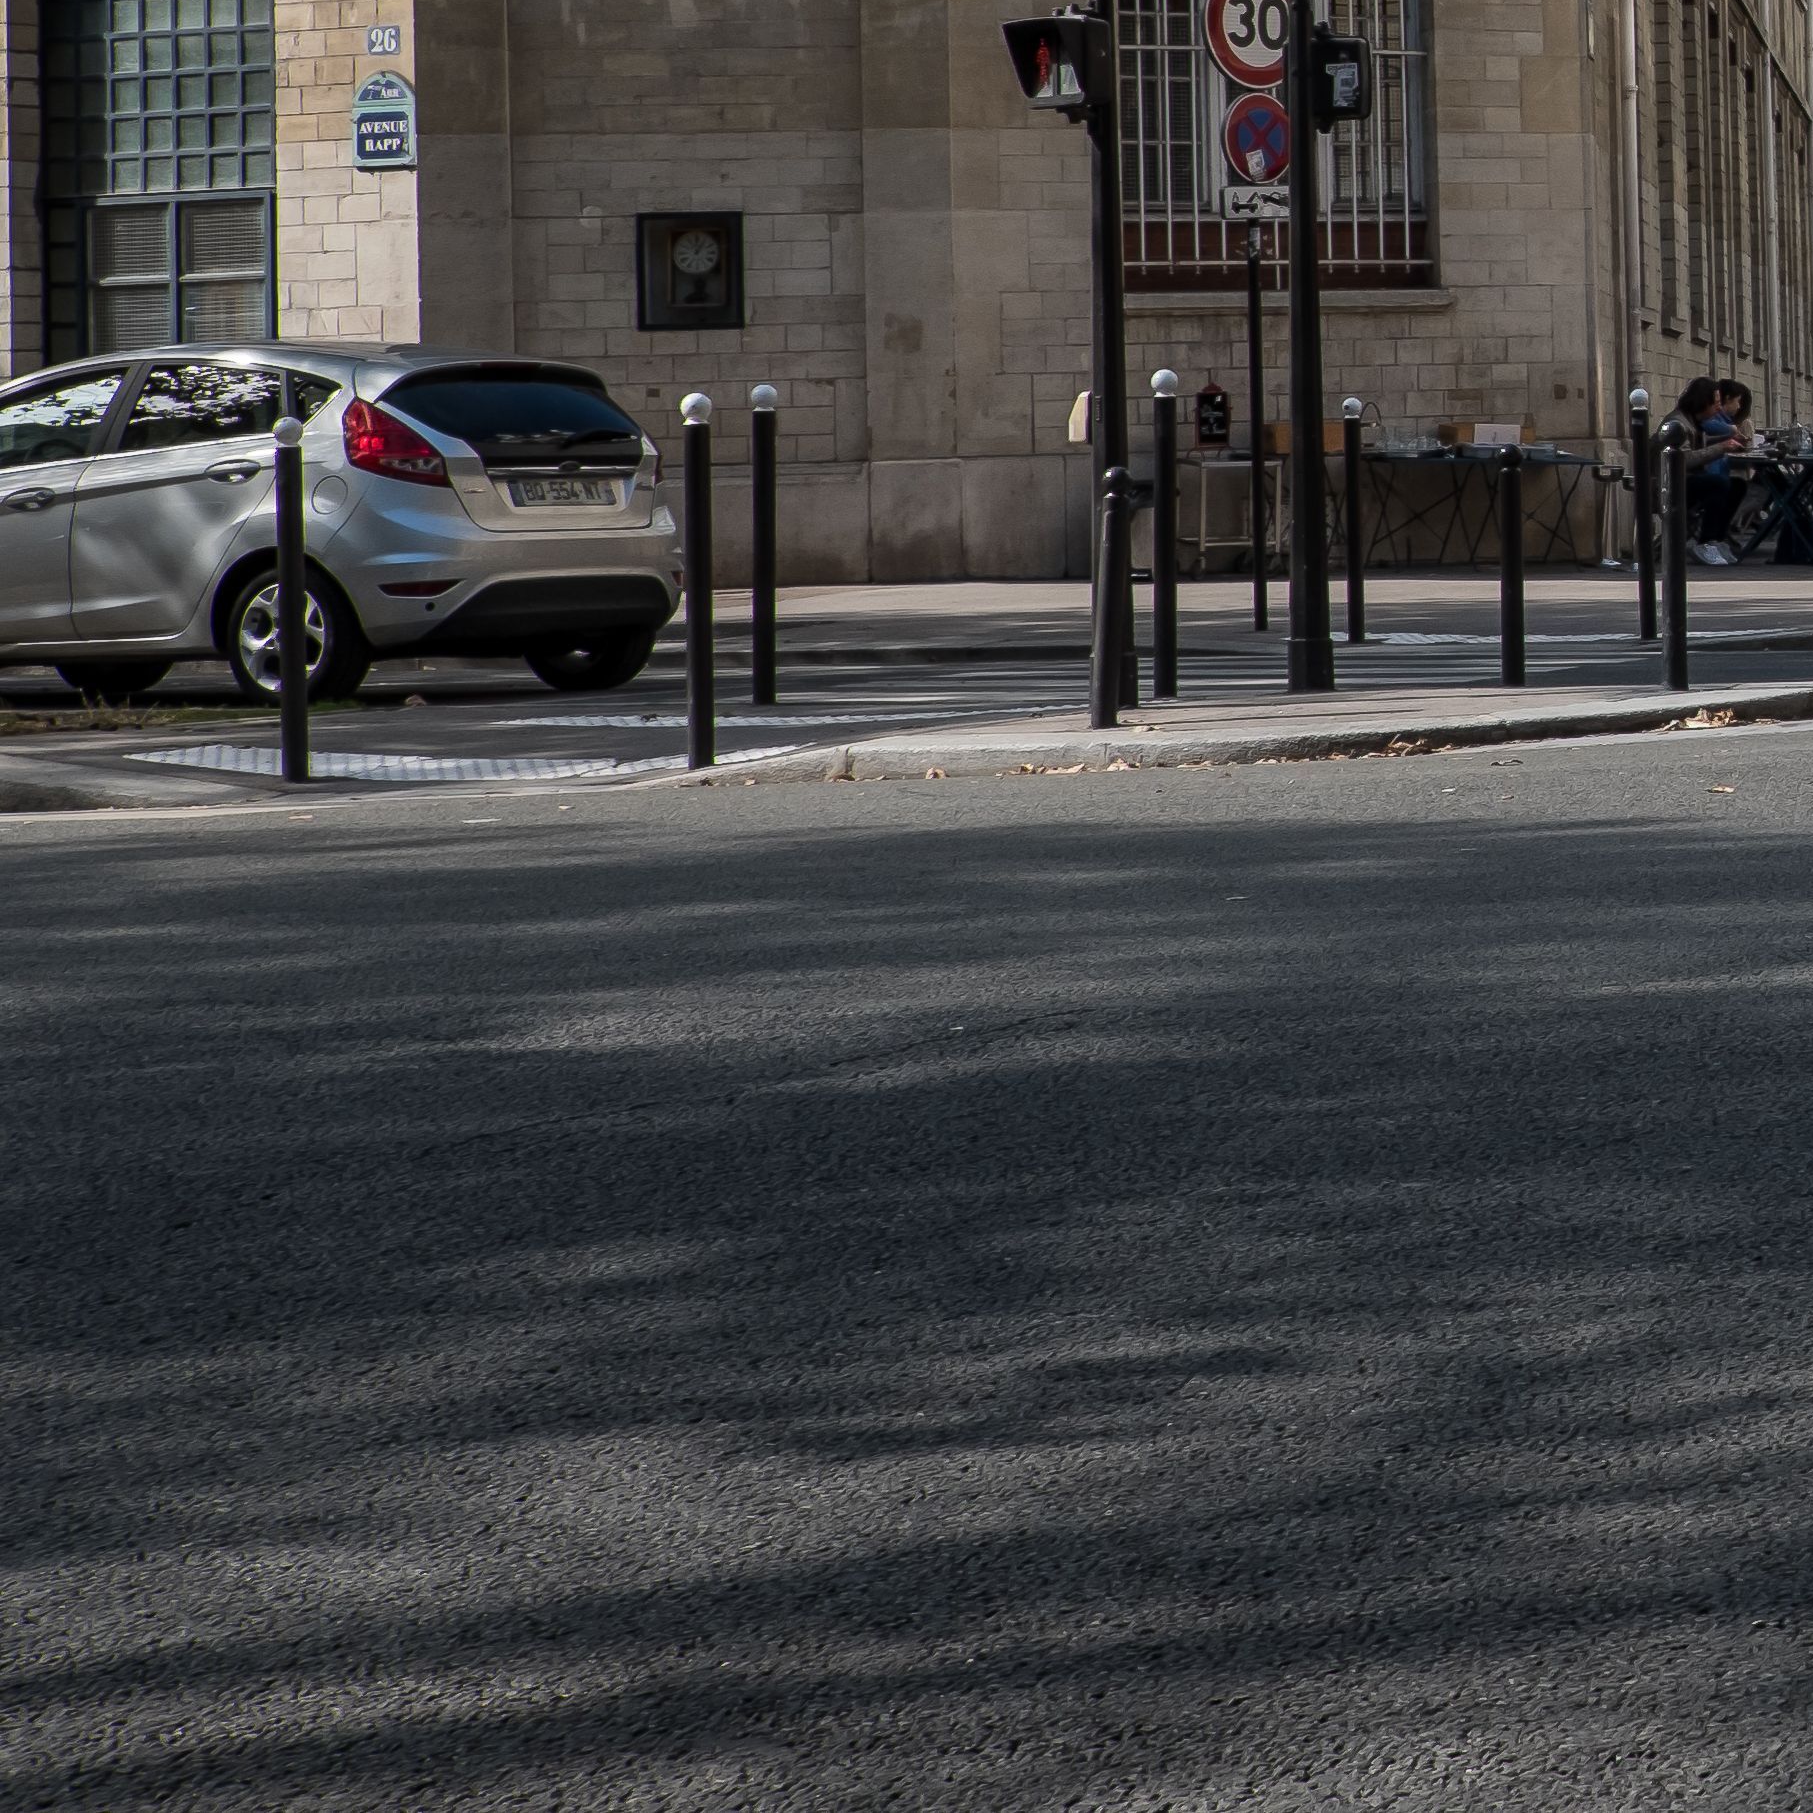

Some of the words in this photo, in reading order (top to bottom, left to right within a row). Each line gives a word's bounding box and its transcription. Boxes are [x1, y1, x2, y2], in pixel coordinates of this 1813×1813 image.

[370, 28, 397, 53] 26
[359, 120, 408, 134] AVENUE
[365, 137, 401, 152] RAPP
